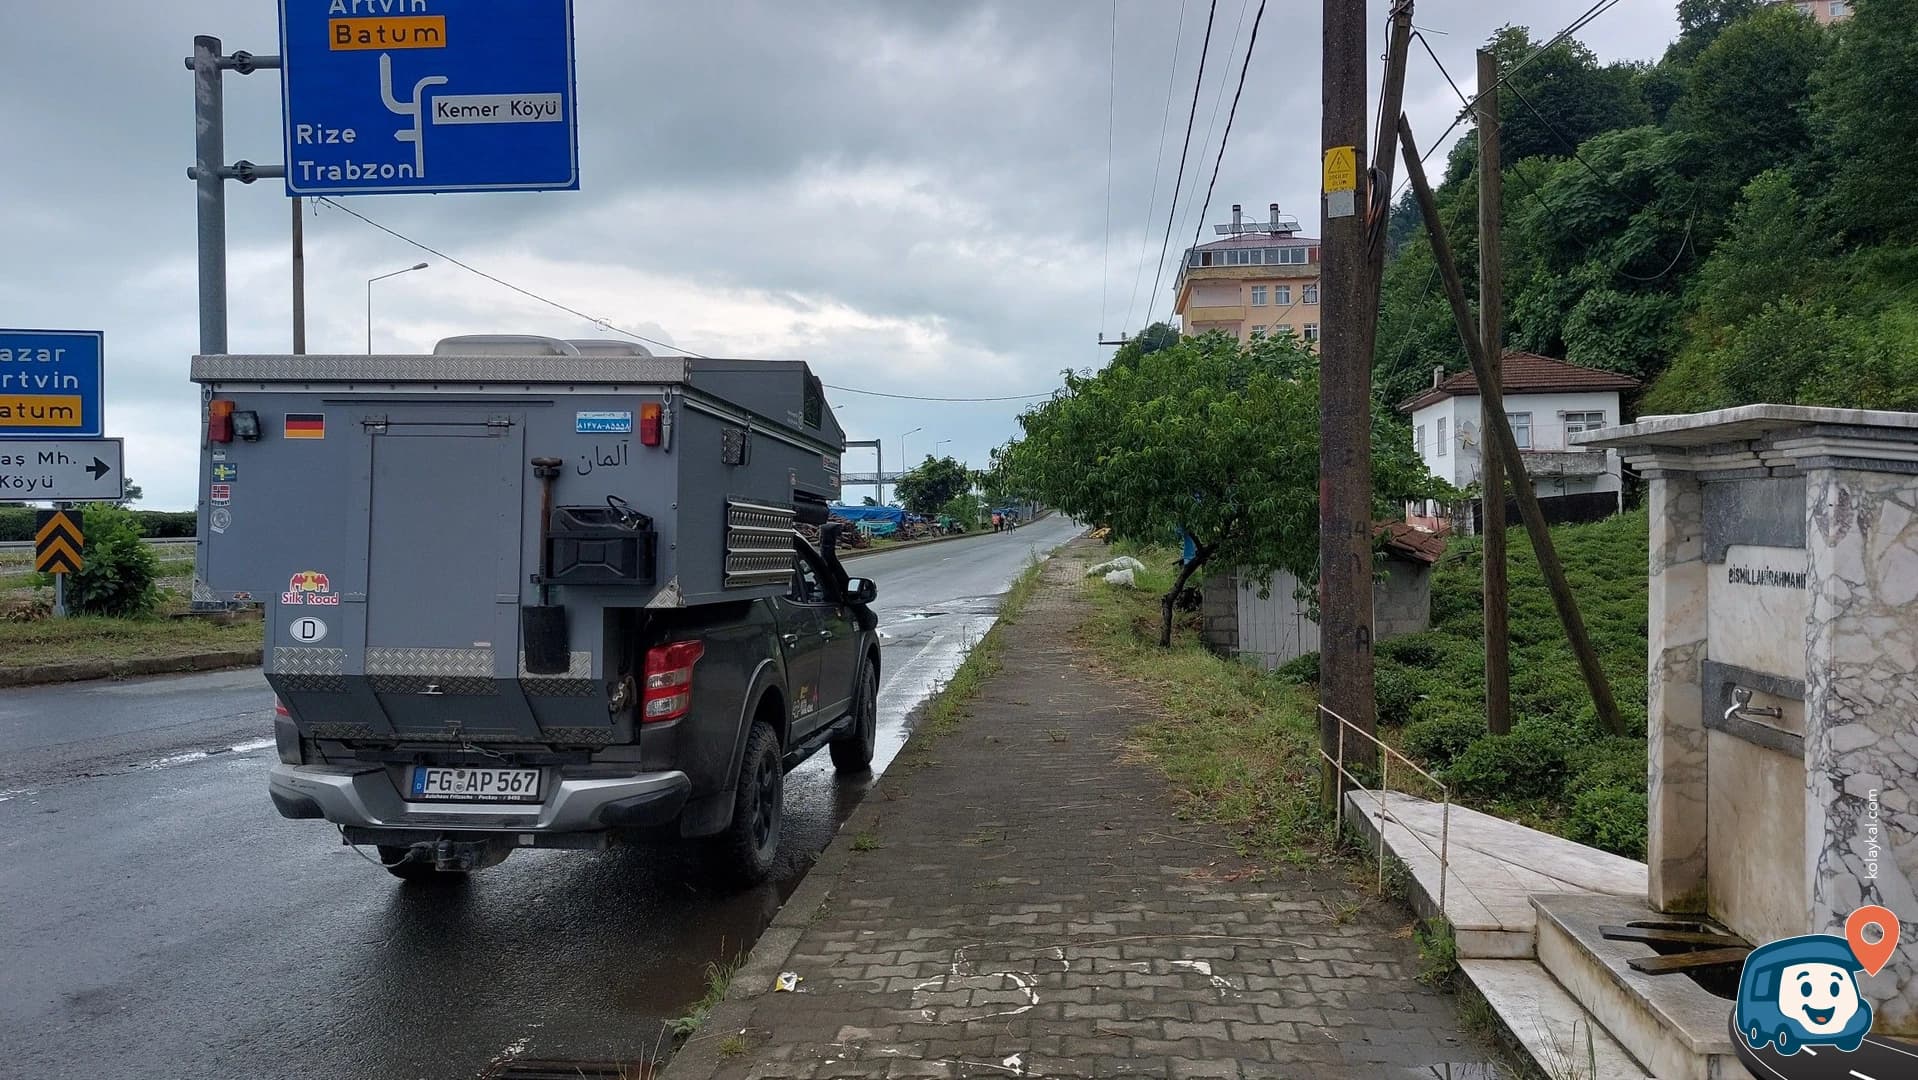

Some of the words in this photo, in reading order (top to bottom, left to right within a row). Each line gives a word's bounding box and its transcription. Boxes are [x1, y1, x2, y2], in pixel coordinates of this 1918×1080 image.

[335, 24, 440, 45] Batum
[437, 102, 500, 119] Kemer
[510, 100, 558, 120] Köyü
[296, 124, 357, 145] Rize
[298, 160, 414, 182] Trabzon
[38, 451, 78, 465] Mh.
[0, 475, 54, 492] Köyü
[282, 592, 303, 605] Silk
[307, 592, 341, 606] Road
[302, 620, 316, 639] D
[425, 770, 453, 791] FG
[465, 771, 494, 792] AP
[497, 772, 537, 793] 567
